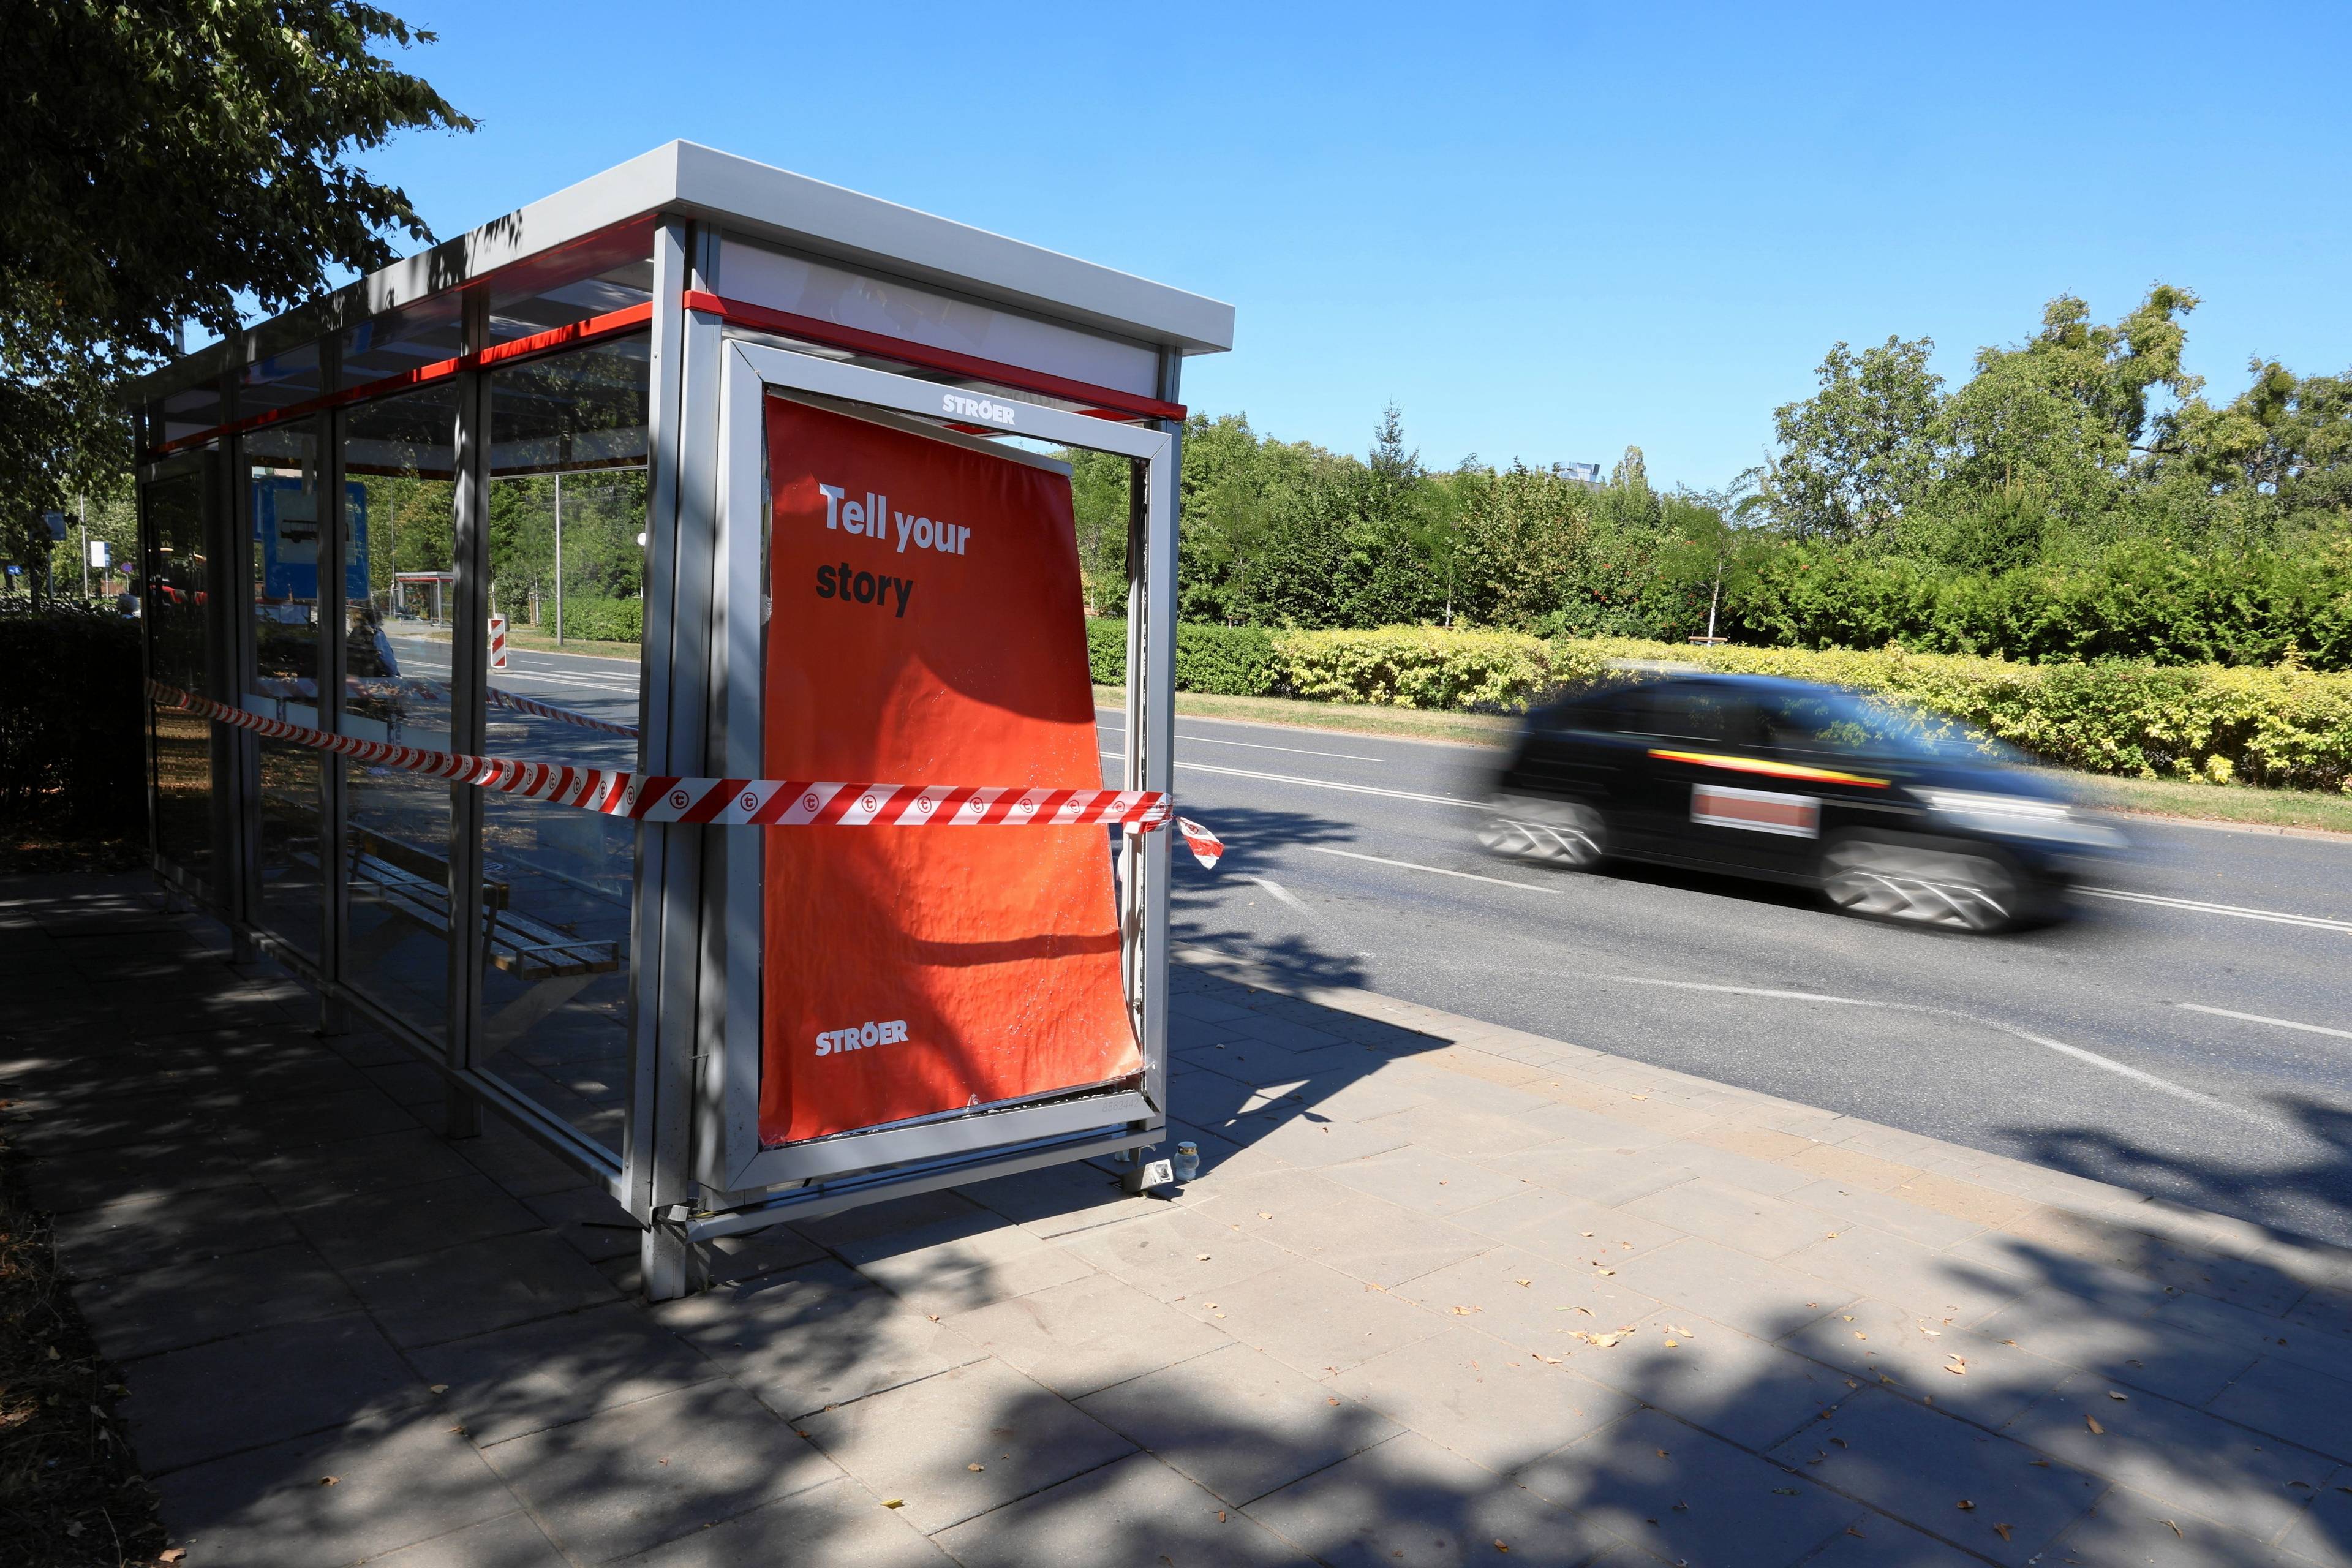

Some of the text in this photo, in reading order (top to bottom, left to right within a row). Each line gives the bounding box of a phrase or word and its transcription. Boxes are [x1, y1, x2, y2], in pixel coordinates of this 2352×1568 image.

[942, 394, 1015, 425] STRÖER
[820, 484, 970, 555] Tell your
[816, 562, 913, 617] story
[815, 1020, 908, 1056] STRÖER
[1102, 1098, 1139, 1112] 8562442
